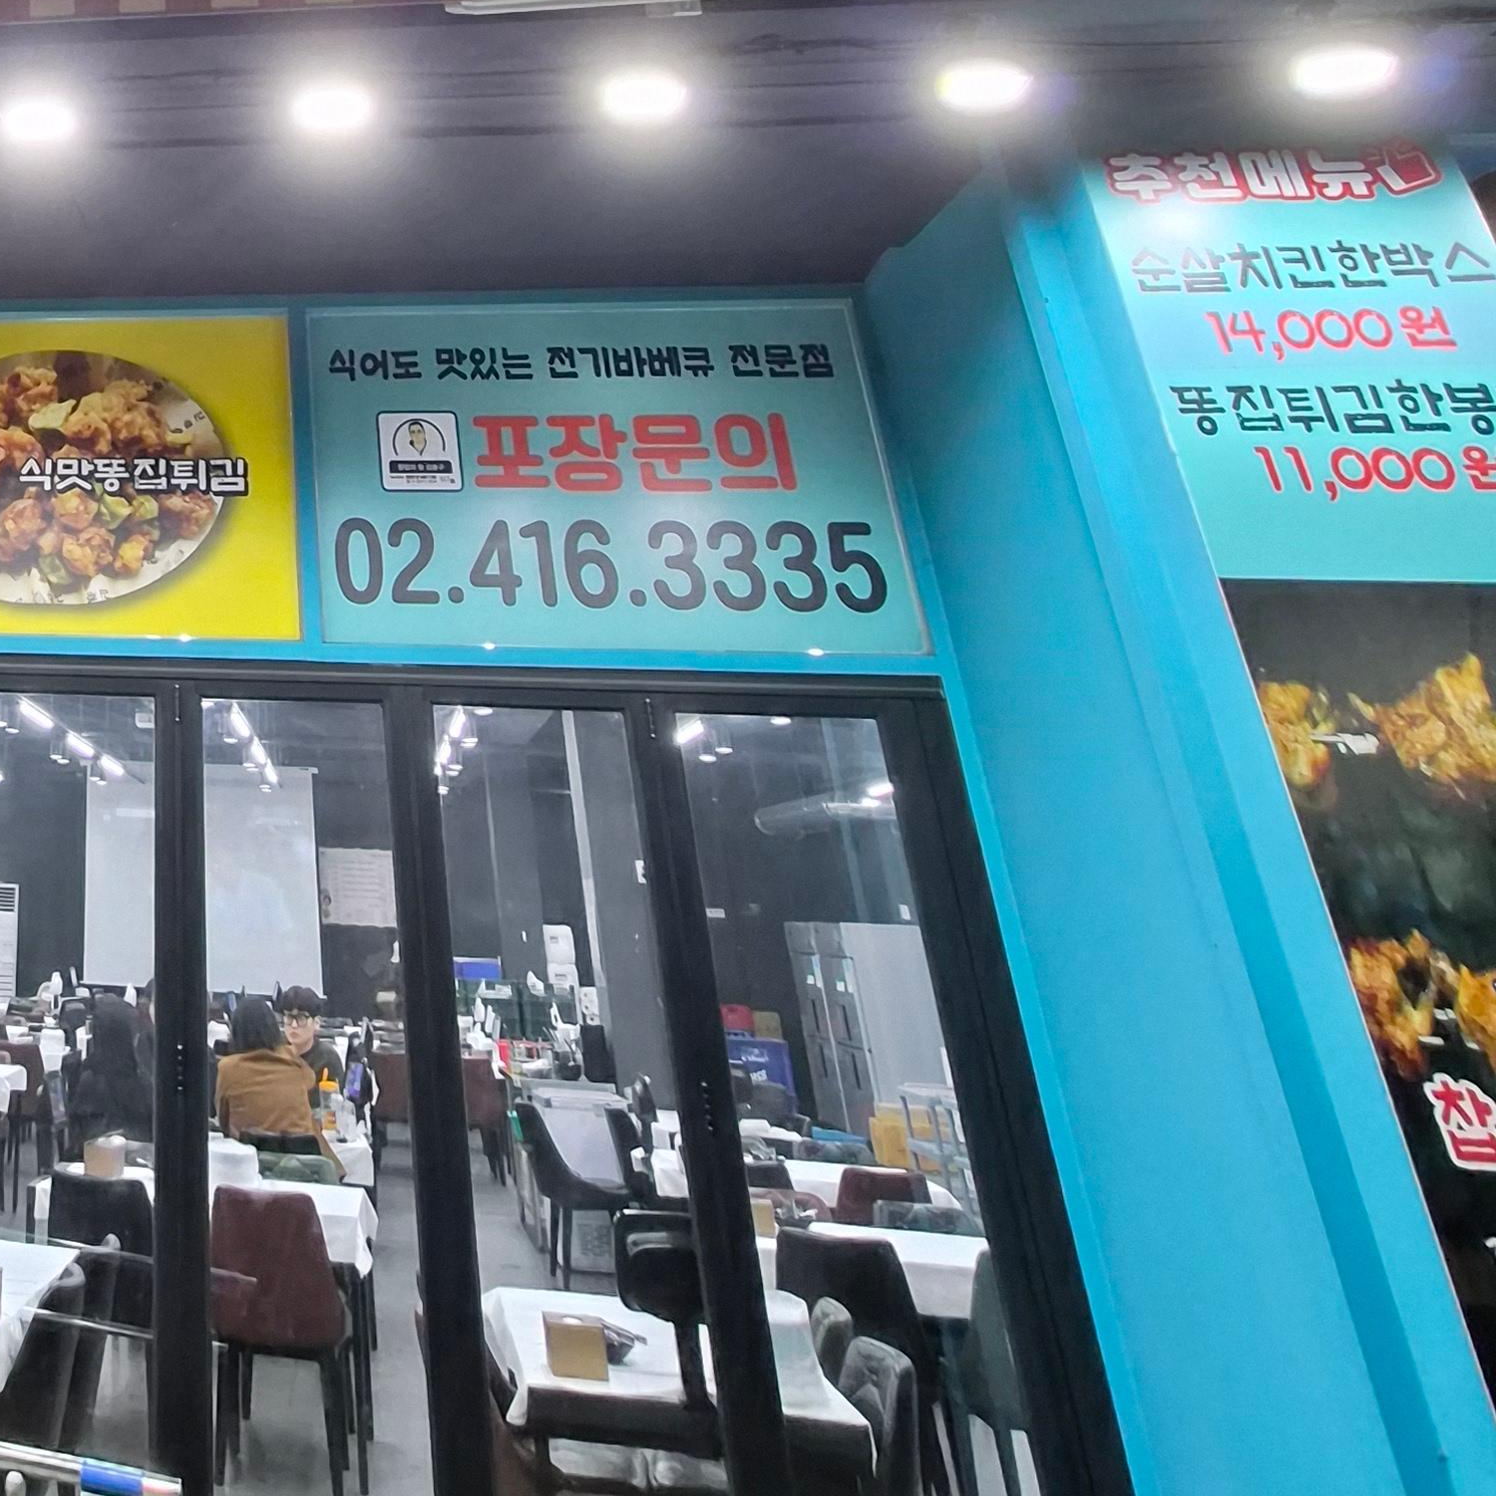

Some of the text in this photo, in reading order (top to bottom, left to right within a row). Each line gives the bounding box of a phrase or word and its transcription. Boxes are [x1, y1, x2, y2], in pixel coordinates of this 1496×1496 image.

[1107, 149, 1376, 203] 추천메뉴
[328, 342, 835, 382] 식어도 맛있는 전기바베큐 전문점
[18, 456, 250, 497] 식맛똥집튀김
[470, 412, 798, 492] 포장문의
[333, 516, 889, 614] 02.416.3335
